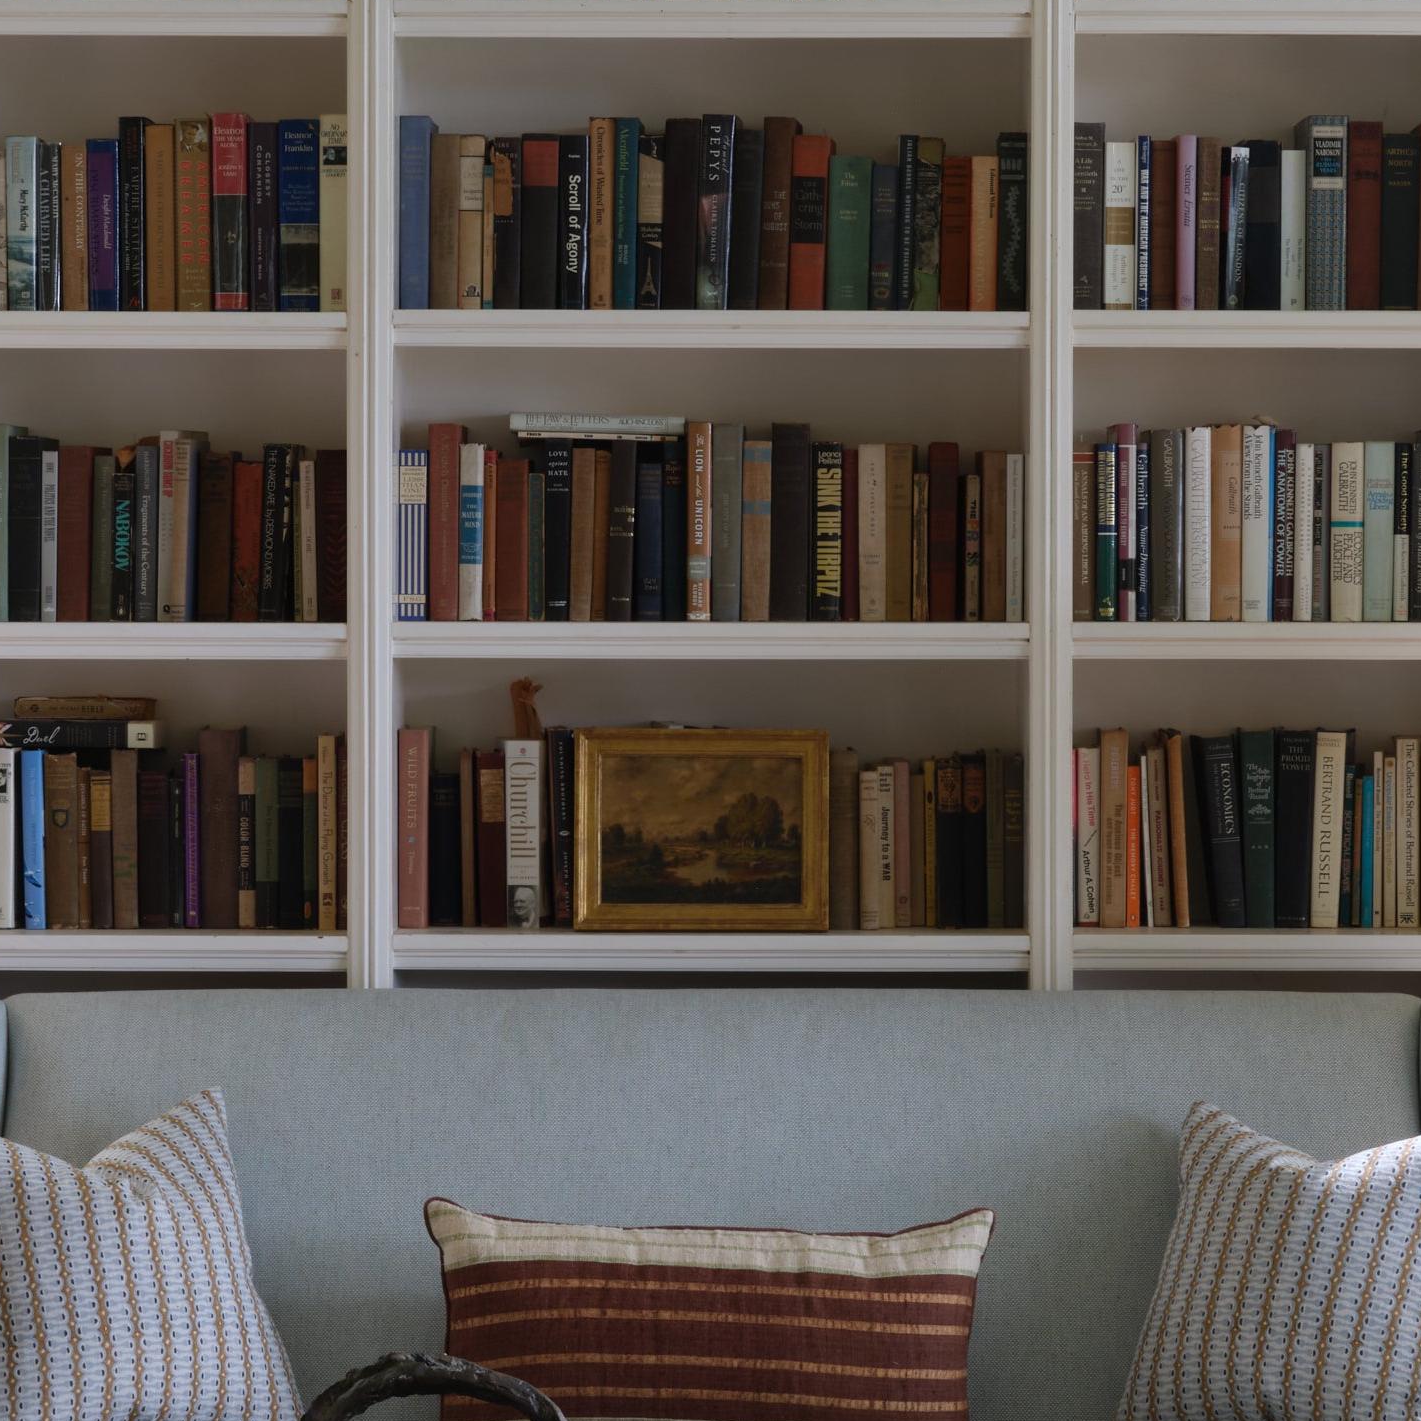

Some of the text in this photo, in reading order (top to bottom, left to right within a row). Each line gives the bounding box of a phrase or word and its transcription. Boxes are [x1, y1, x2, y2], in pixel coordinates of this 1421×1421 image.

[255, 144, 264, 205] COMPANION
[263, 152, 272, 197] CLOSEST
[708, 124, 720, 182] PEPYS
[74, 153, 85, 251] ON THE CONTRARY
[130, 166, 141, 287] EMPIRE STATESMAN
[565, 174, 581, 273] Scroll of Agony
[1138, 169, 1149, 291] WAR AND THE AMERICAN PRESIDENCY
[1234, 182, 1247, 283] CITIZENS OF LONDON
[694, 448, 704, 472] LION
[1164, 438, 1174, 487] GALBRAITH
[1253, 433, 1264, 519] John Kenneth Galbraith
[1338, 461, 1349, 512] GALBRAITH
[1348, 460, 1358, 515] JOHN KENNETH
[1397, 450, 1409, 533] The Good Society
[115, 499, 131, 572] NABOKOV
[138, 494, 151, 597] Fragments of the Century
[693, 499, 704, 546] UNICORN
[815, 467, 842, 598] SINK THE TIRPITZ
[1137, 454, 1149, 594] Galbraith Name-Dropping
[1275, 449, 1286, 577] THE ANATOMY OF POWER
[1285, 449, 1295, 577] JOHN KENNETH GALBRAITH
[1332, 533, 1343, 582] LAUGHTER
[1342, 533, 1353, 584] PEACE AND
[1352, 531, 1363, 586] ECONOMICS
[22, 726, 61, 745] Duel
[1281, 763, 1313, 771] TOWER
[407, 746, 418, 829] WILD FRUITS
[509, 761, 537, 859] Churchill
[1220, 762, 1235, 835] ECONOMICS
[239, 816, 249, 869] COLOR BLIND
[1318, 755, 1334, 899] BERTRAND RUSSELL
[1405, 743, 1415, 907] The Collected Stories of Bertrand Russell
[1081, 850, 1096, 914] Arthur A. Cohen
